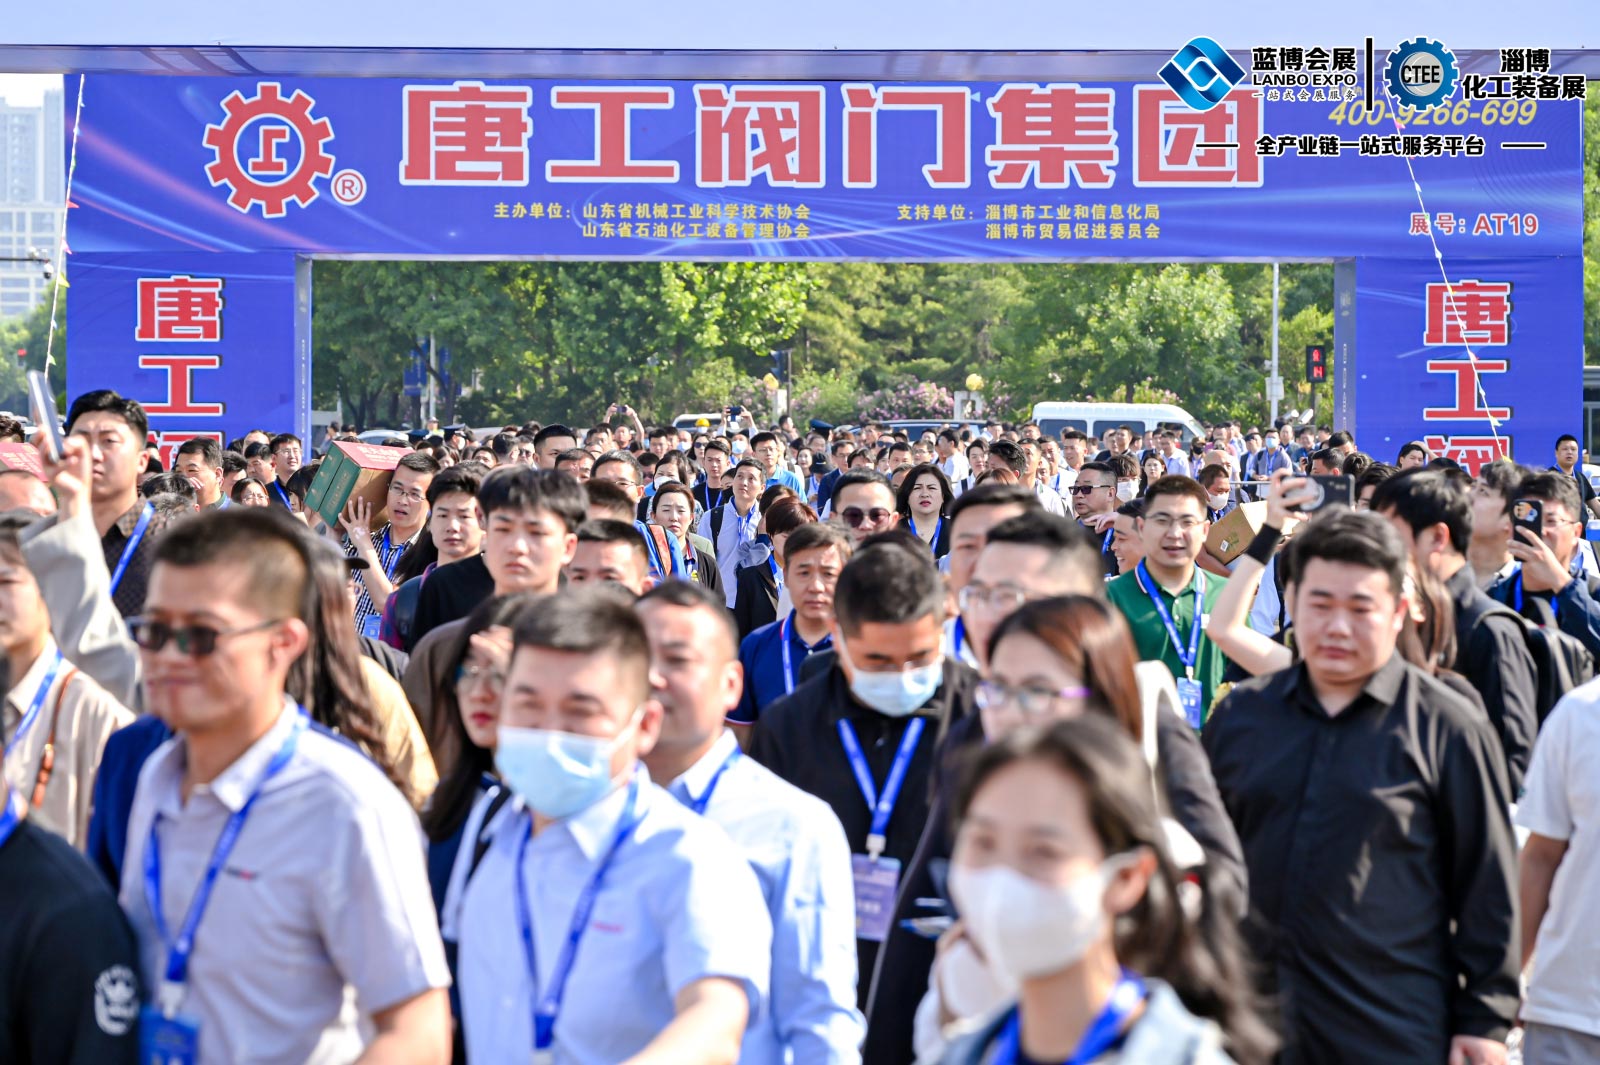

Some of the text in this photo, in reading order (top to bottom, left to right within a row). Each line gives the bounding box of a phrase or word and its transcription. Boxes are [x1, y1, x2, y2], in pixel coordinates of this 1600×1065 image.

[1328, 100, 1537, 126] 400-9266-699
[400, 81, 1264, 188] 唐工阀门集团
[582, 222, 811, 239] 山东省石油化工设备管理协会
[985, 223, 1160, 239] 淄博市贸易促进委员会
